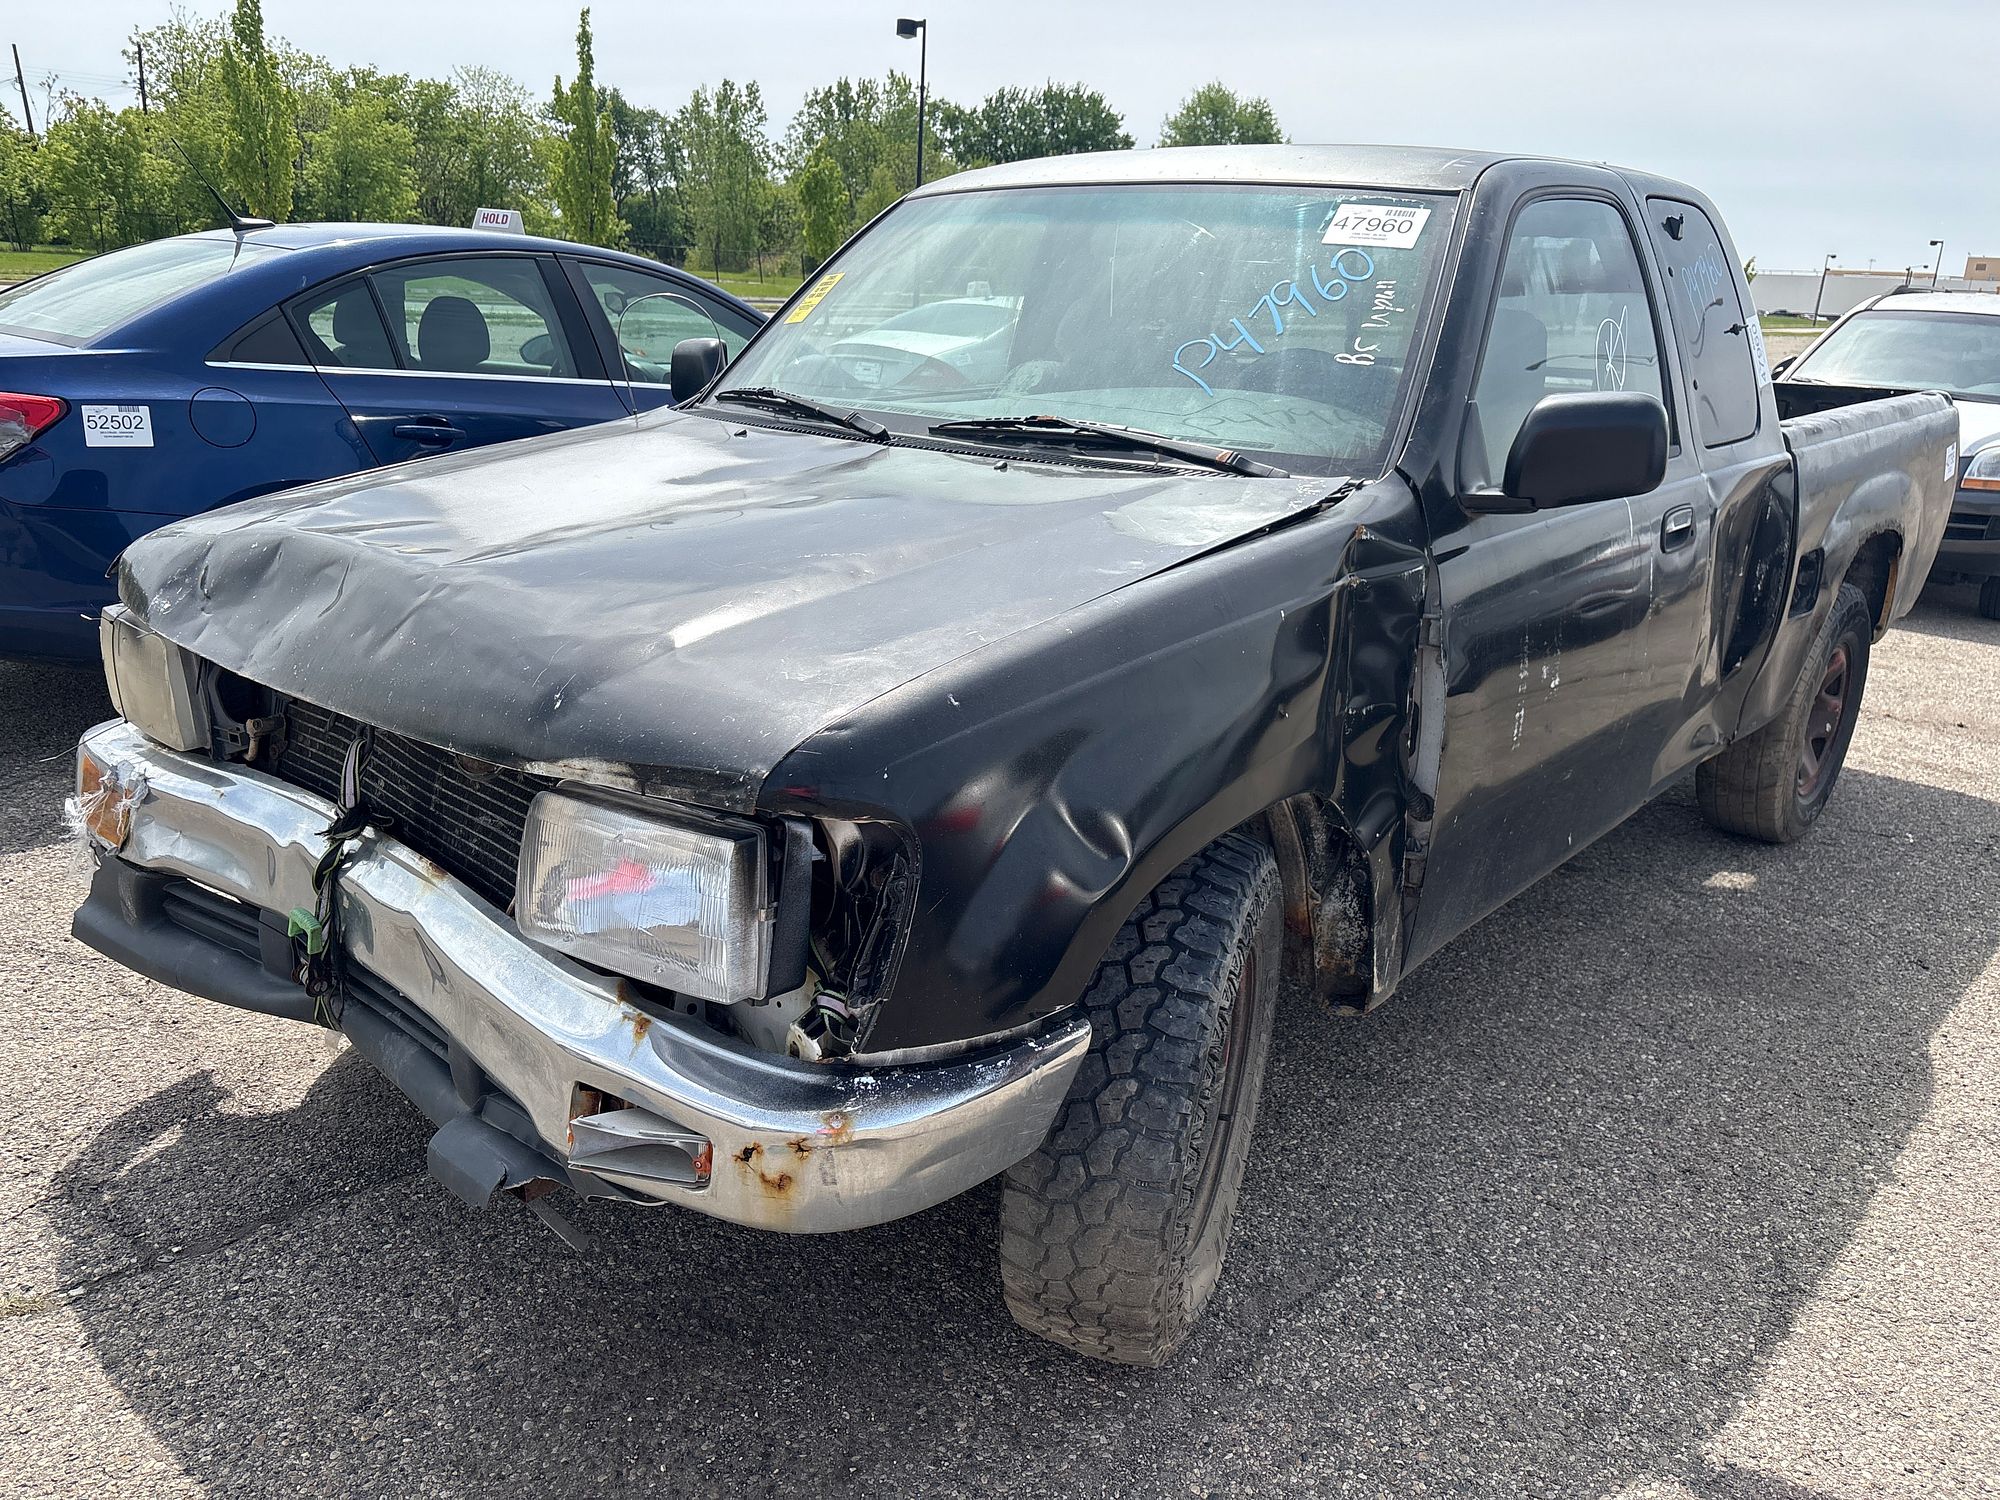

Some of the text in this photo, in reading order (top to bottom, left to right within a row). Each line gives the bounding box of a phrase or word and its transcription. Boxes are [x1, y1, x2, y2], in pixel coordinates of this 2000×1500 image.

[482, 212, 509, 225] HOLD
[1333, 216, 1413, 234] 47960
[1172, 248, 1375, 397] P47960
[87, 415, 144, 429] 52502
